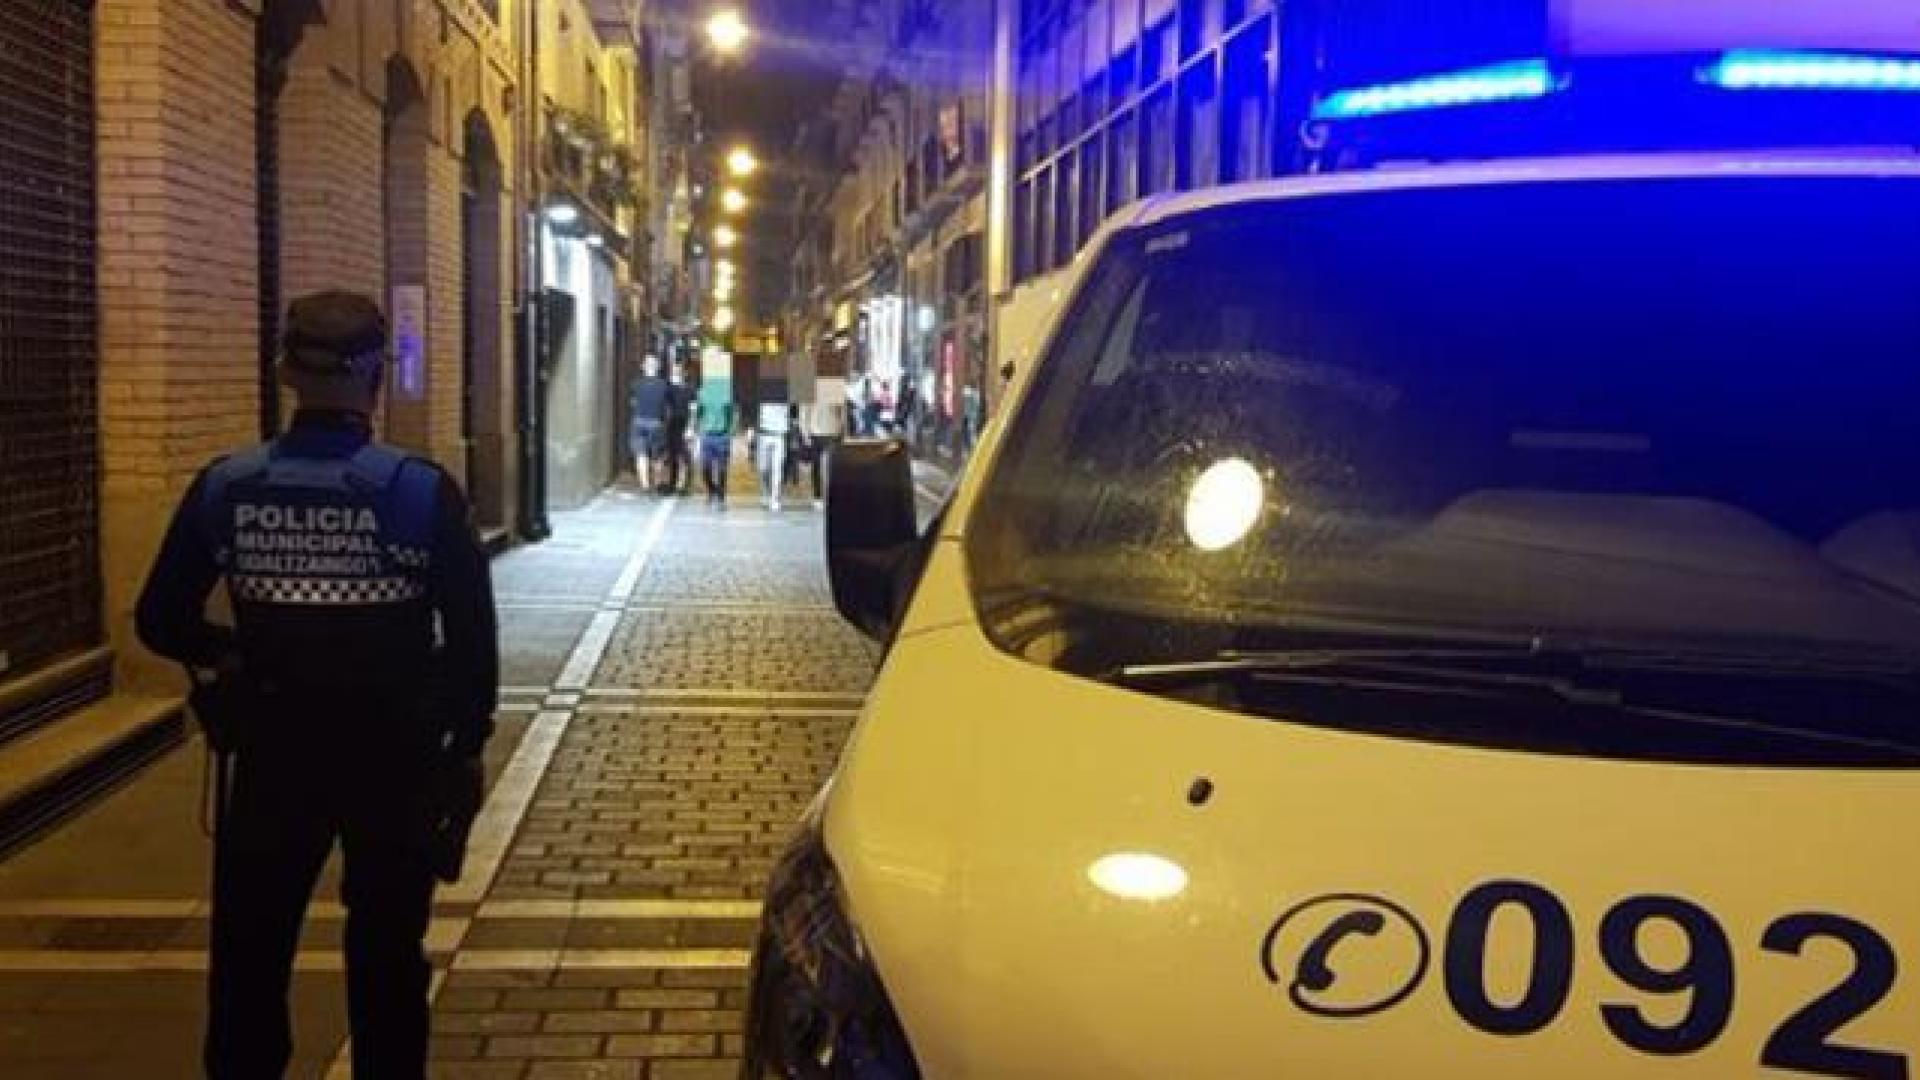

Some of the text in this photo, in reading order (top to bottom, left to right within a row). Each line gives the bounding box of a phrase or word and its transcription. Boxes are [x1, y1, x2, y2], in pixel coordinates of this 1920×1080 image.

[235, 504, 377, 530] POLICIA
[236, 531, 379, 552] MUNICIPAL
[1443, 879, 1909, 1080] 092
